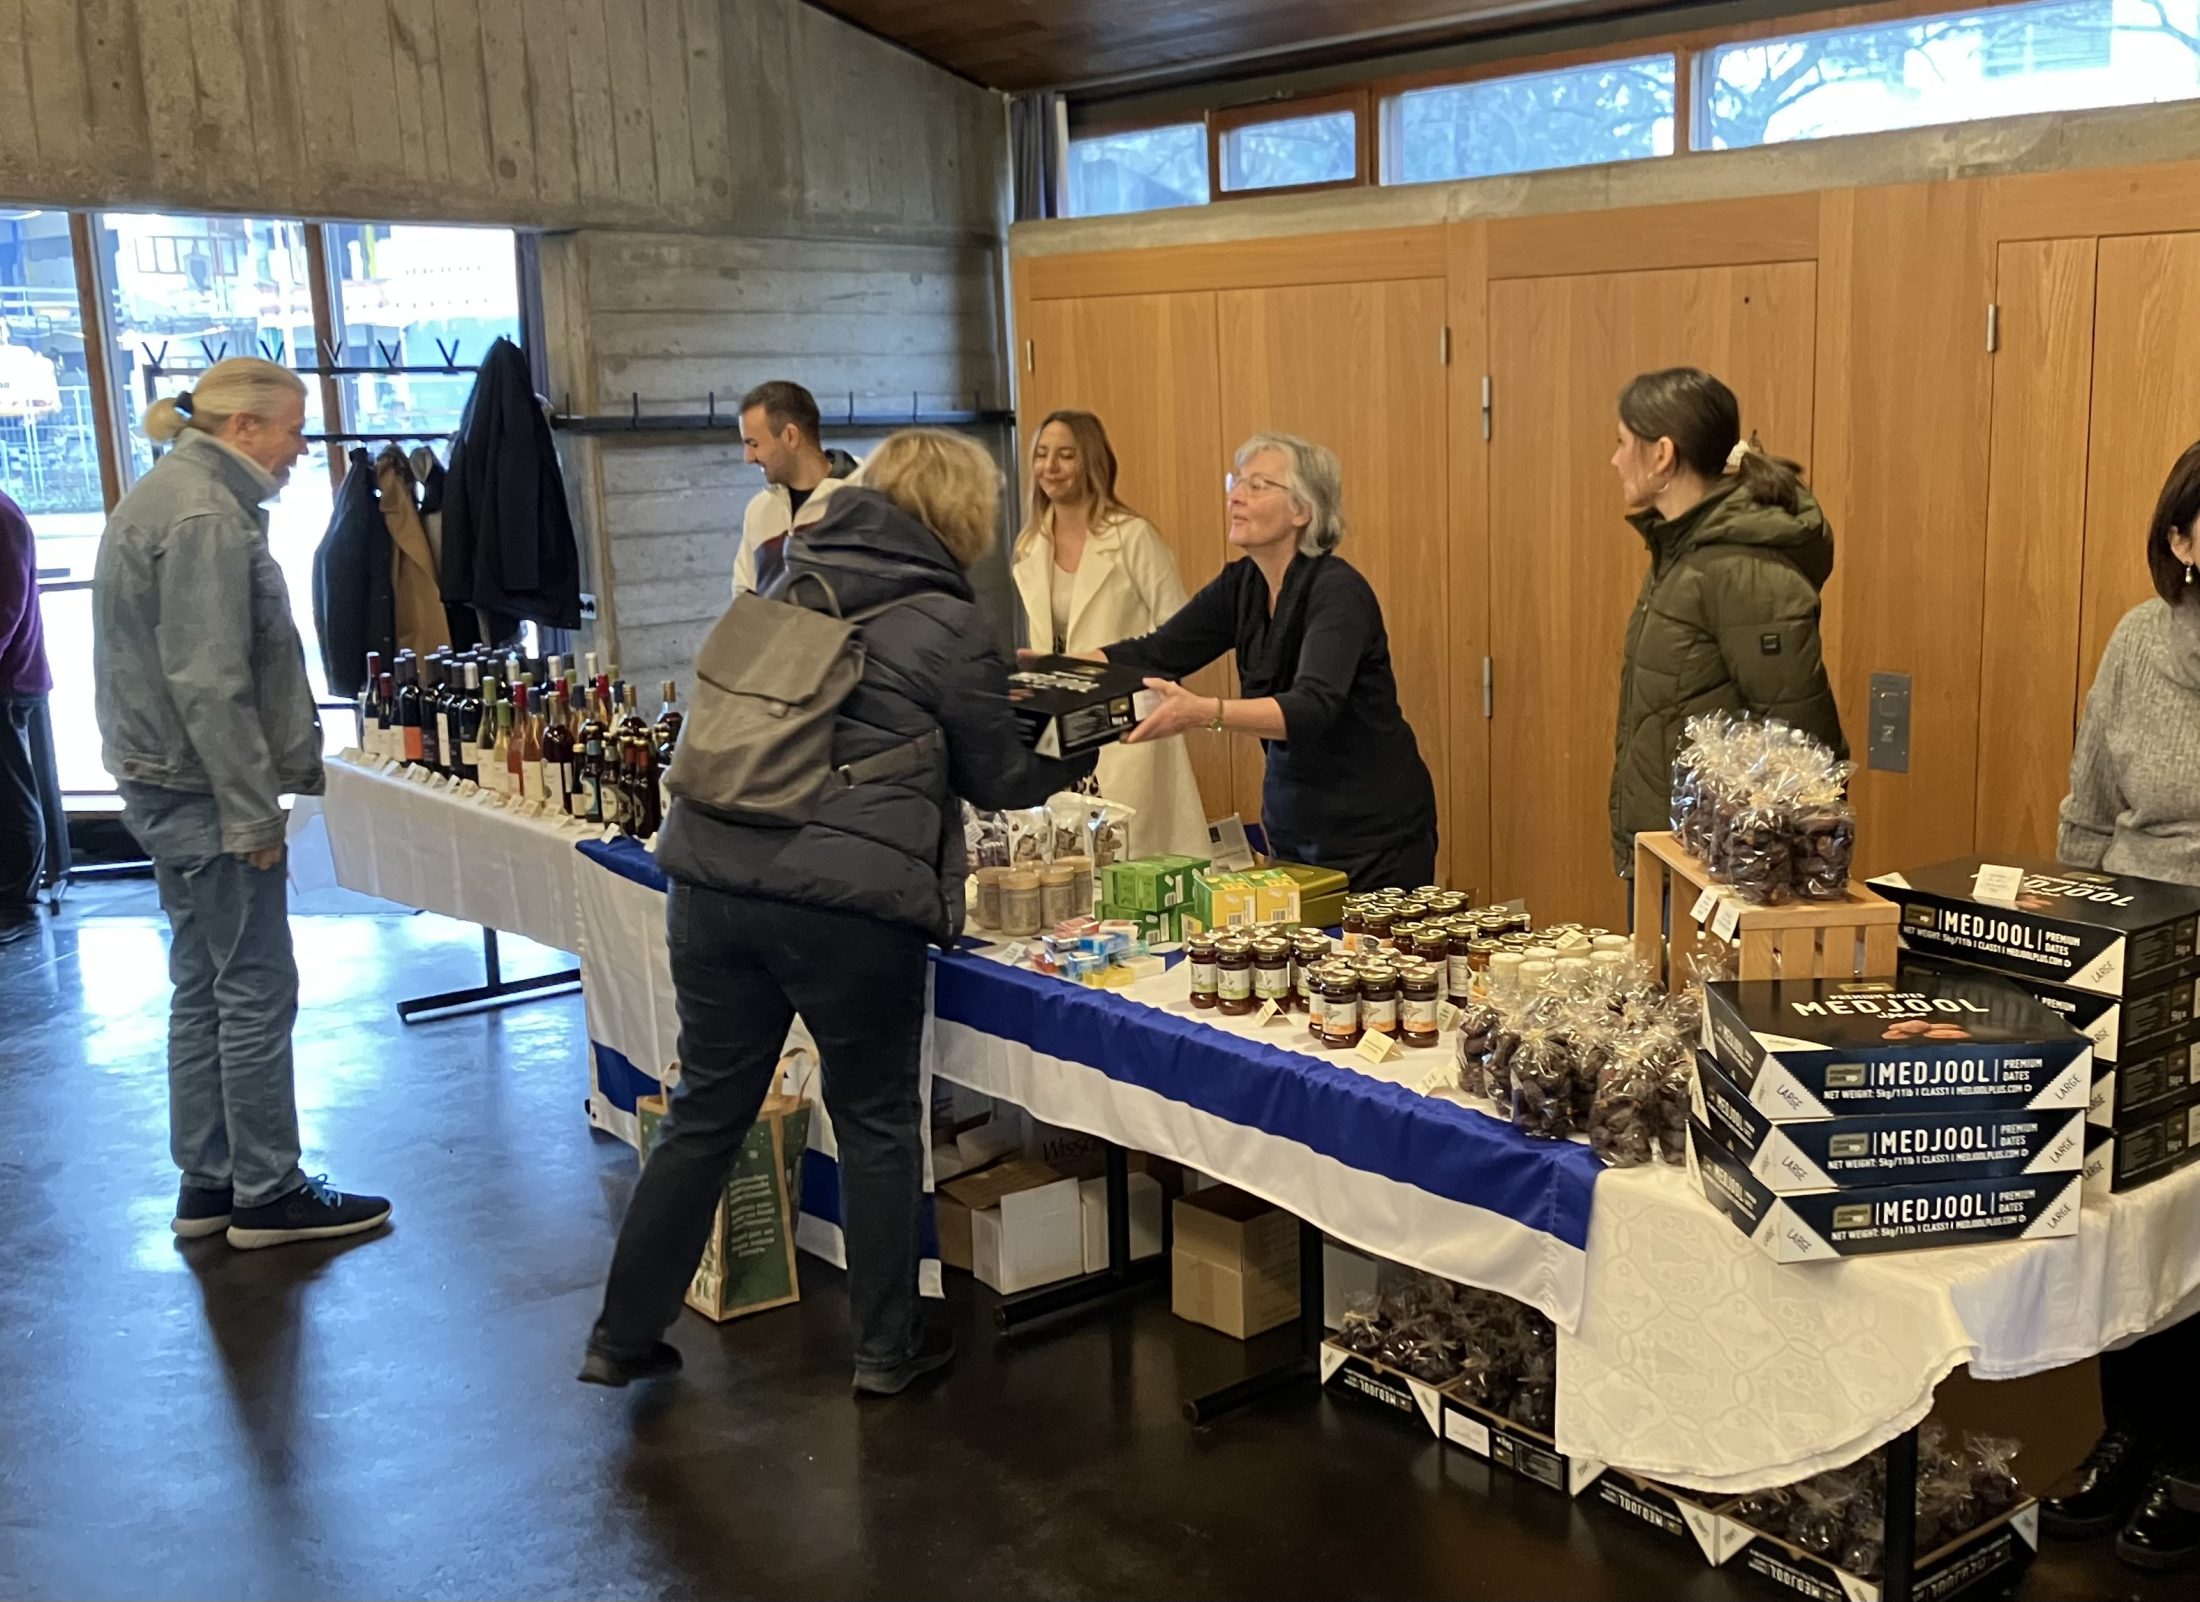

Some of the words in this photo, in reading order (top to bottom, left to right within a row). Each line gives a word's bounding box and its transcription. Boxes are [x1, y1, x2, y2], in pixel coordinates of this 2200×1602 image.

[1945, 910, 2035, 950] MEDJOOL
[2045, 931, 2081, 946] PREMIUM
[2044, 942, 2069, 956] DATES
[2091, 960, 2115, 983] LARGE
[1791, 998, 1990, 1017] MEDJOOL
[1879, 1059, 1990, 1086] MEDJOOL
[2003, 1058, 2043, 1070] PREMIUM
[2003, 1071, 2030, 1082] DATES
[2055, 1073, 2081, 1100] LARGE
[1776, 1084, 1803, 1110] LARGE
[1823, 1090, 1840, 1099] NET
[2000, 1123, 2039, 1134] PREMIUM
[1881, 1125, 1988, 1155] MEDJOOL
[2001, 1135, 2026, 1147] DATES
[2049, 1137, 2075, 1164] LARGE
[1782, 1156, 1808, 1182] LARGE
[1827, 1160, 1844, 1170] NET
[1999, 1189, 2036, 1201] PREMIUM
[1883, 1193, 1987, 1225] MEDJOOL
[1999, 1202, 2024, 1213] DATES
[2047, 1204, 2073, 1230] LARGE
[1787, 1228, 1812, 1253] LARGE
